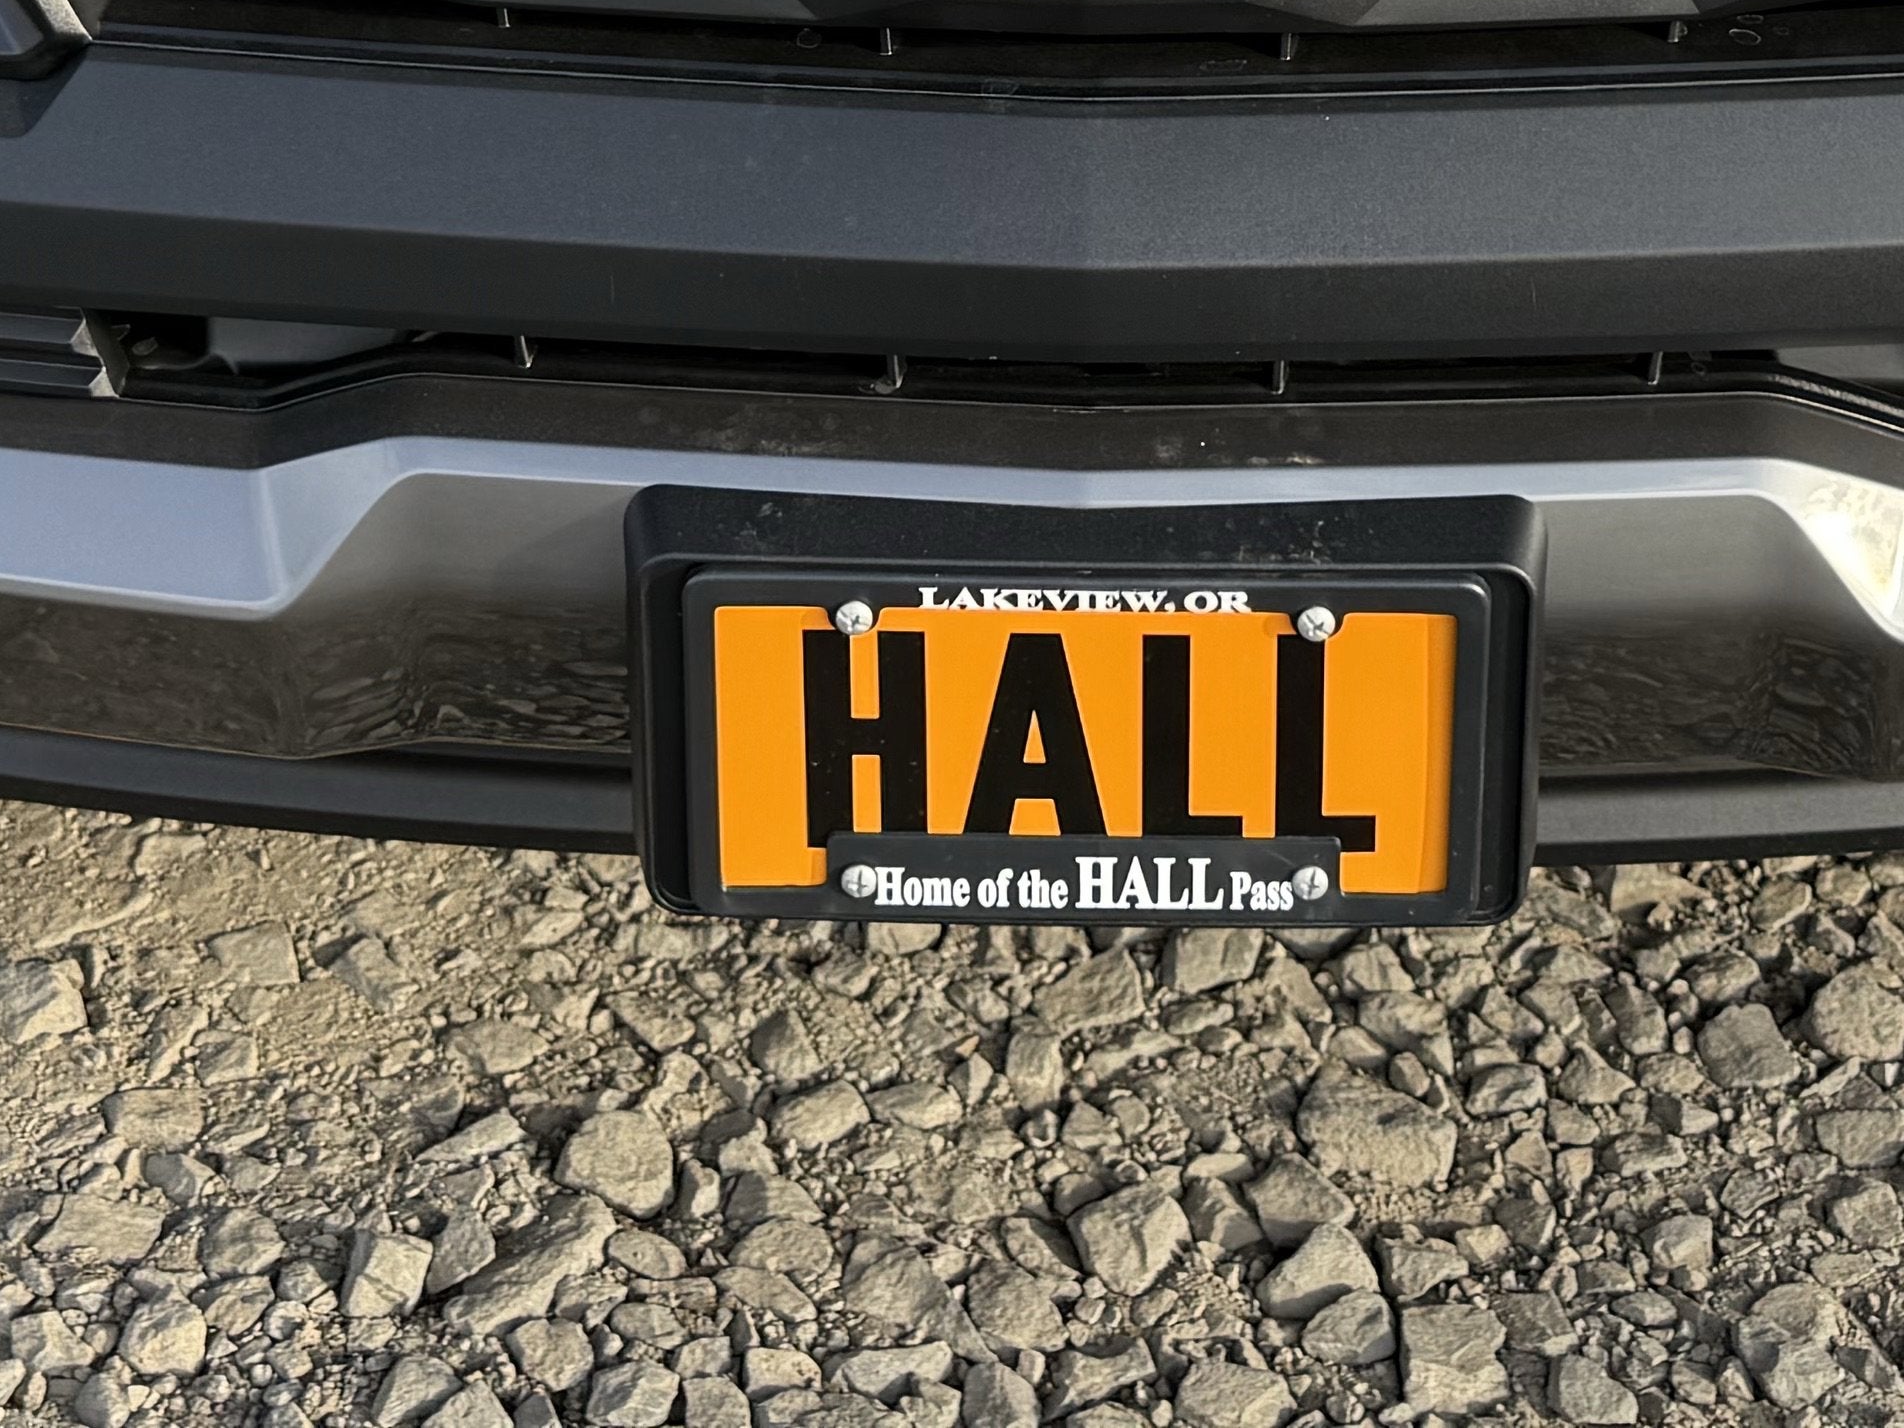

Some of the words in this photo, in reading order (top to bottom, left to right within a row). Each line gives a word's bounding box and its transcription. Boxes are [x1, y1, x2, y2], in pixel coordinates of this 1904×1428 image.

[918, 586, 1176, 615] LAKEVIEW,
[1183, 590, 1253, 614] OR
[801, 628, 1377, 853] HALL
[874, 865, 972, 908] Home
[977, 867, 1014, 909] of
[1016, 868, 1069, 910] the
[1074, 854, 1225, 911] HALL
[1228, 870, 1295, 912] Pass
